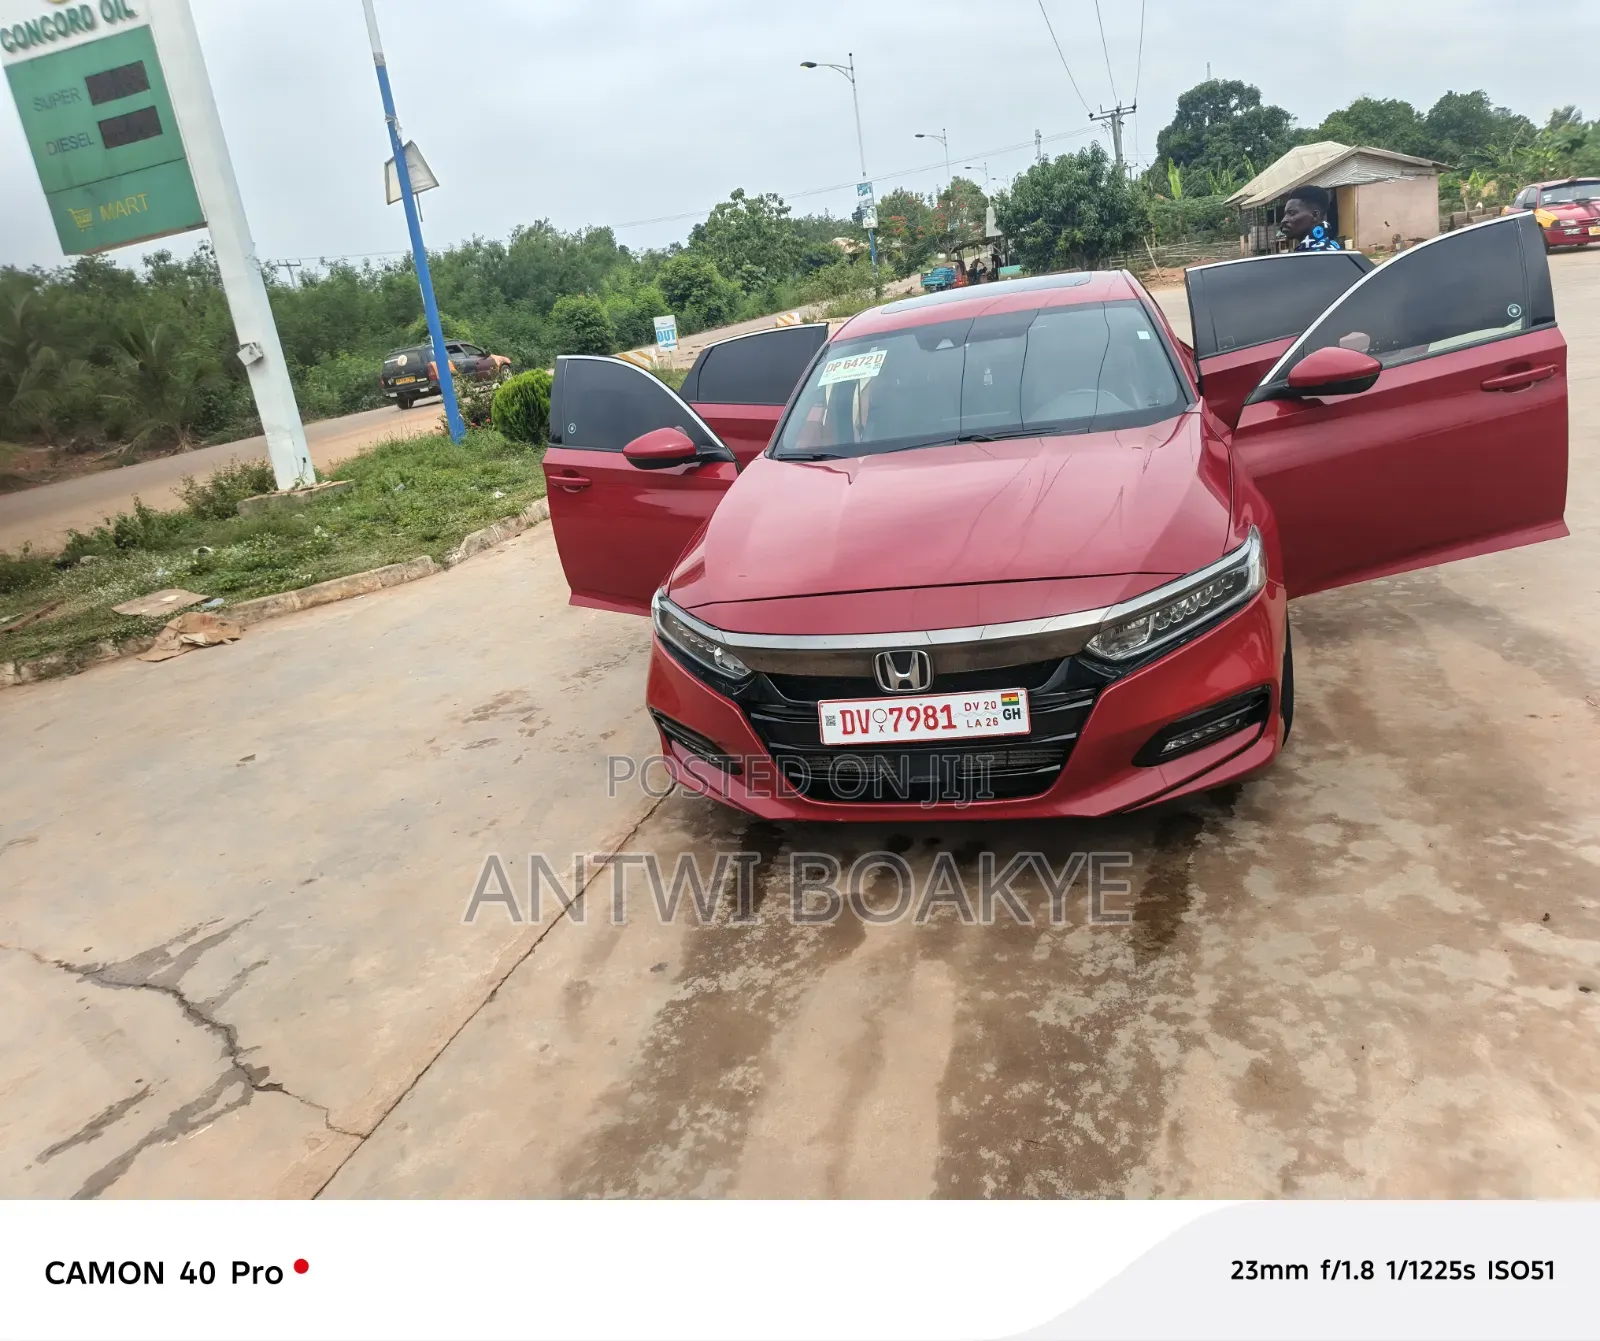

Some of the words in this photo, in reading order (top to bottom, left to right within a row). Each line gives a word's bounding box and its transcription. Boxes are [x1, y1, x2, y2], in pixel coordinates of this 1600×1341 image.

[0, 4, 97, 53] CONCORD
[99, 0, 138, 24] OIL
[33, 87, 82, 112] SUPER
[46, 132, 95, 156] DIESEL
[99, 193, 148, 222] MART
[656, 329, 675, 342] OUT
[964, 702, 979, 712] DV
[983, 701, 997, 710] 20
[1002, 707, 1021, 720] GH
[839, 709, 870, 735] DV
[888, 704, 957, 733] 7981
[966, 718, 982, 728] LA
[985, 717, 999, 727] 26
